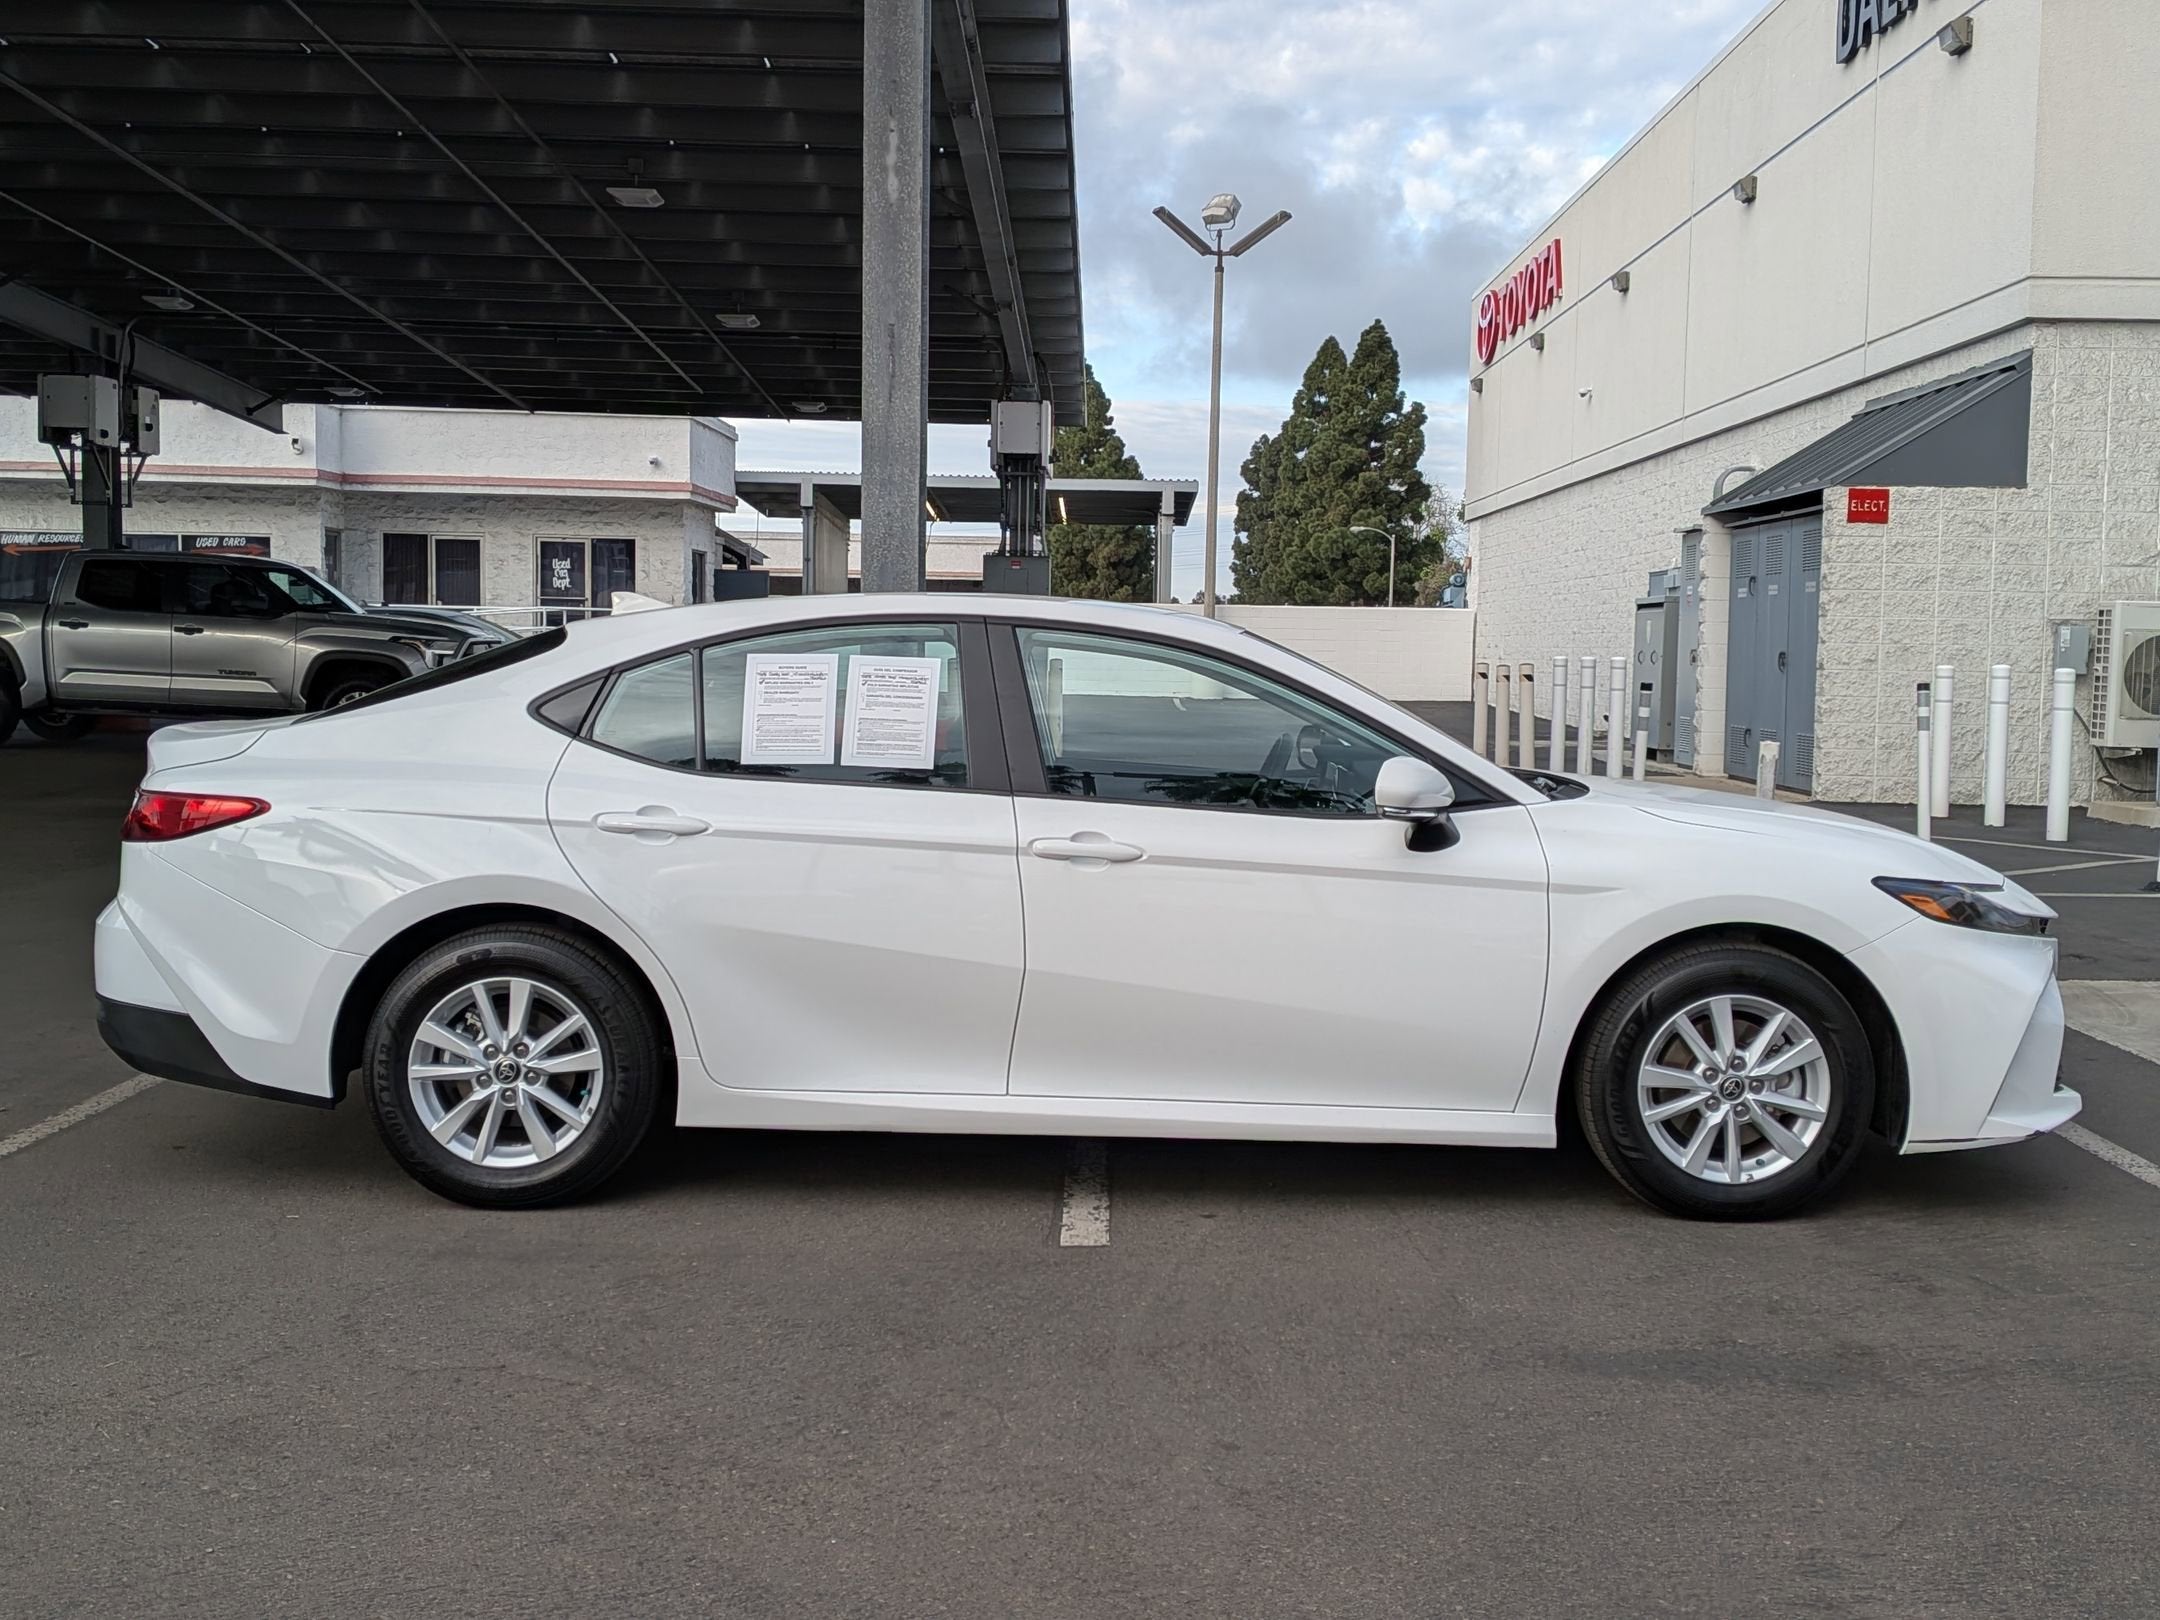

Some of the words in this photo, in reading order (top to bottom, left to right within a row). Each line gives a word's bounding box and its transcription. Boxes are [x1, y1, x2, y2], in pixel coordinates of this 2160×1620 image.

[1498, 238, 1563, 342] TOYOTA
[1851, 499, 1887, 512] ELECT.
[0, 533, 36, 545] HUMAN
[195, 537, 219, 548] USED
[222, 537, 247, 547] CARS
[552, 557, 571, 569] Used
